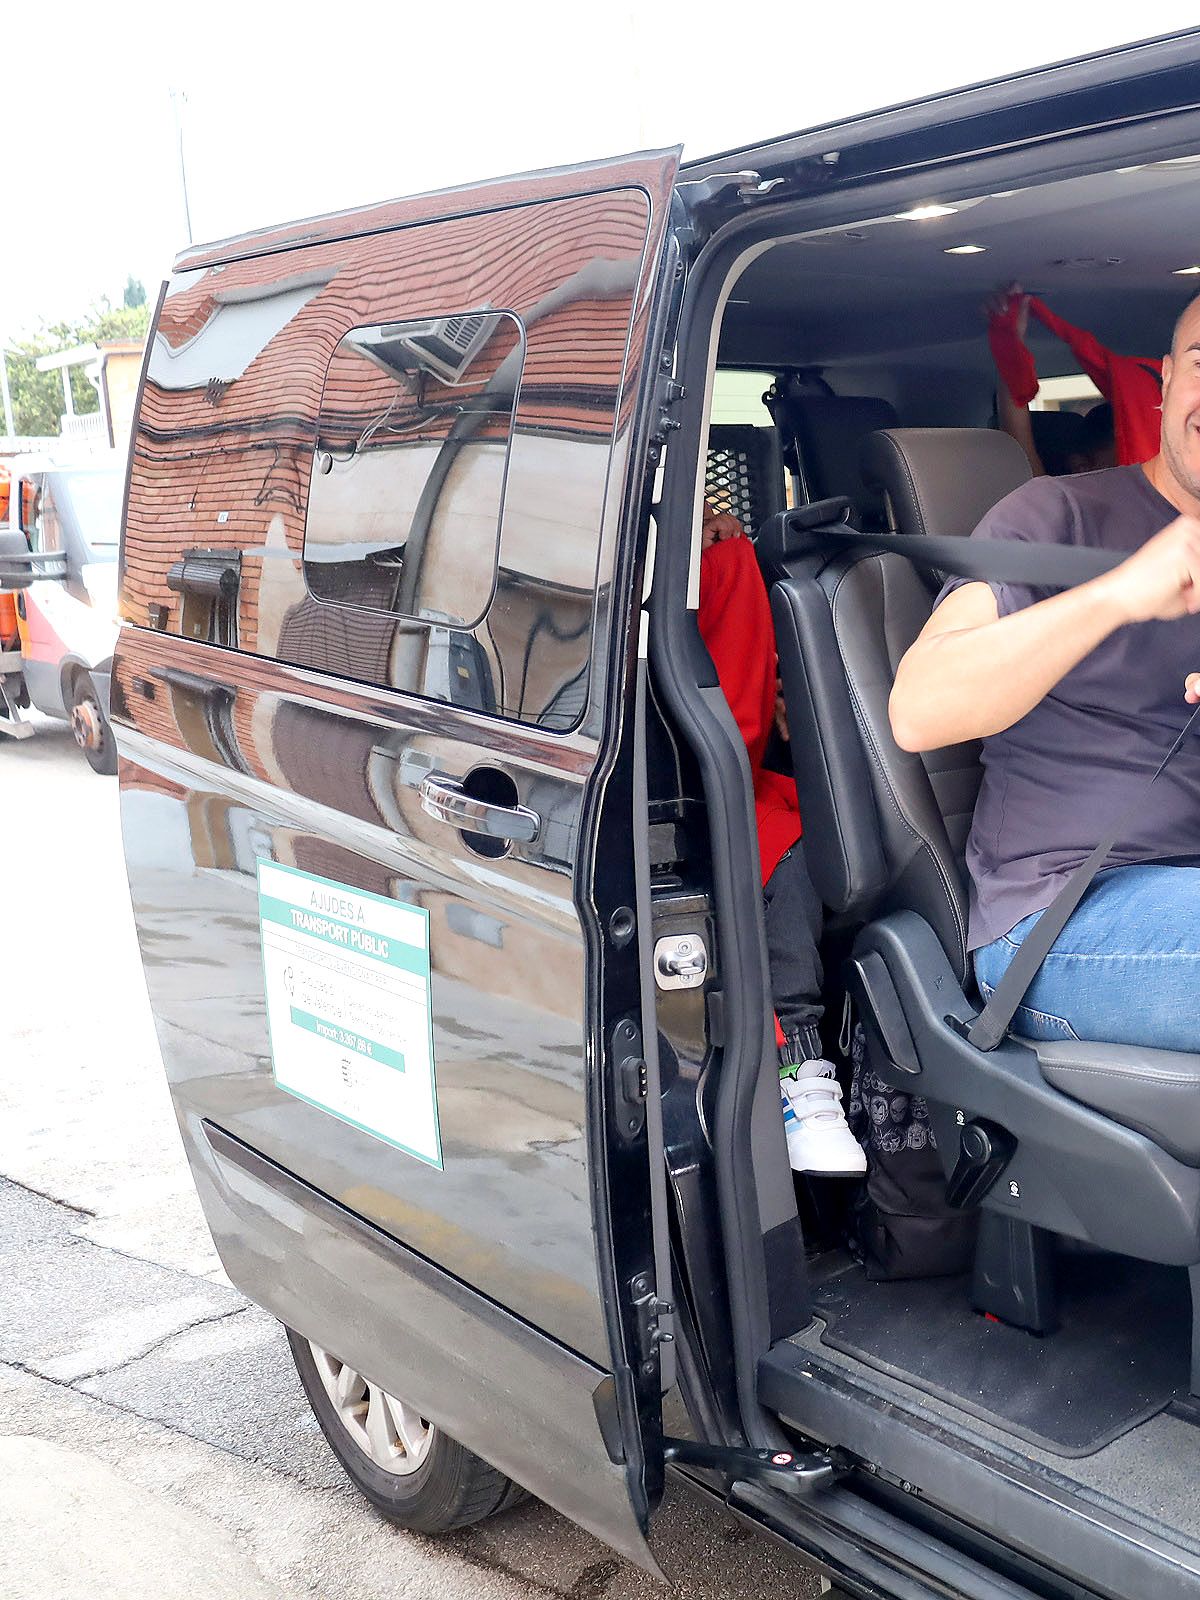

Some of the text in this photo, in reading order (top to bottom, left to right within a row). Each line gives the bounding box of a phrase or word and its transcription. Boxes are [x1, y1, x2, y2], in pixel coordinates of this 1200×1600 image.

[310, 890, 365, 923] AJUDES A
[288, 908, 390, 960] TRANSPORT PÚBLIC
